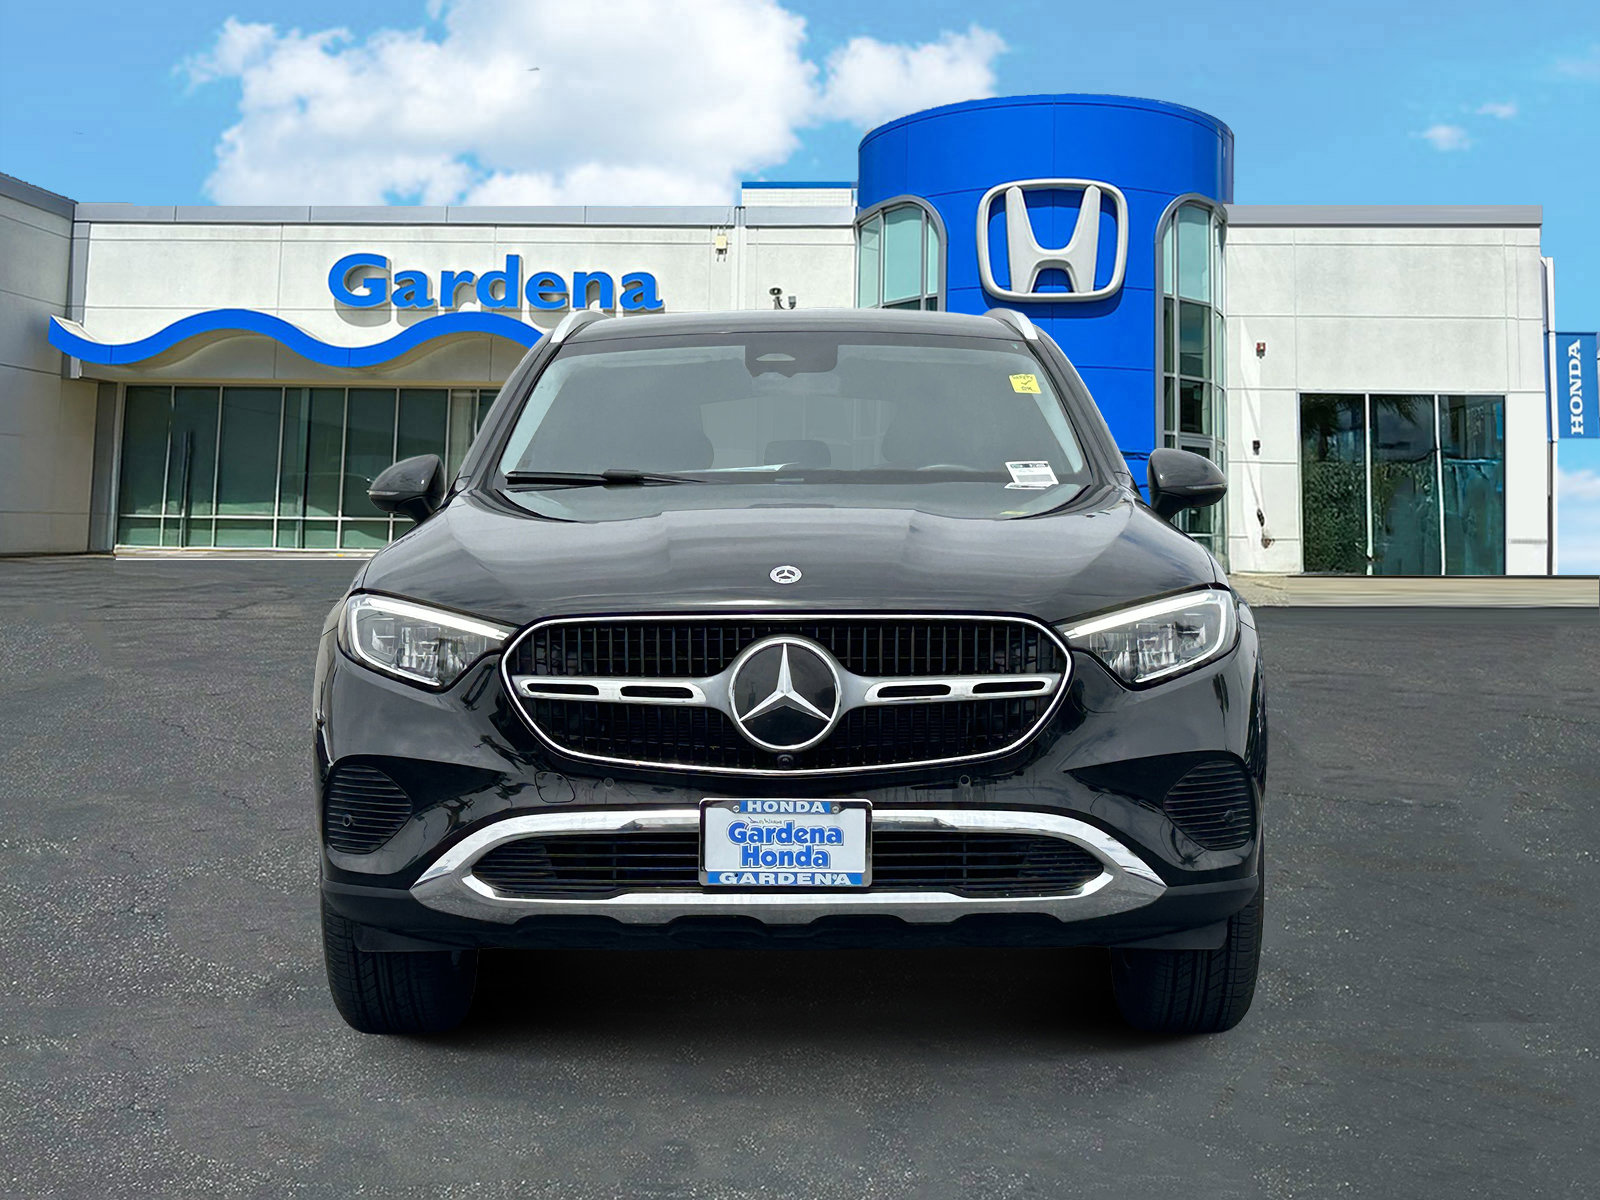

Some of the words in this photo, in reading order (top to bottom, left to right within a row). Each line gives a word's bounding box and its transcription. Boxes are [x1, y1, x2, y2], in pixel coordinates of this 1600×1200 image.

[328, 253, 664, 309] Gardena
[1568, 339, 1584, 435] HONDA
[747, 801, 825, 813] HONDA
[728, 821, 843, 845] Gardena
[741, 845, 829, 867] Honda
[719, 872, 851, 885] GARDENA
